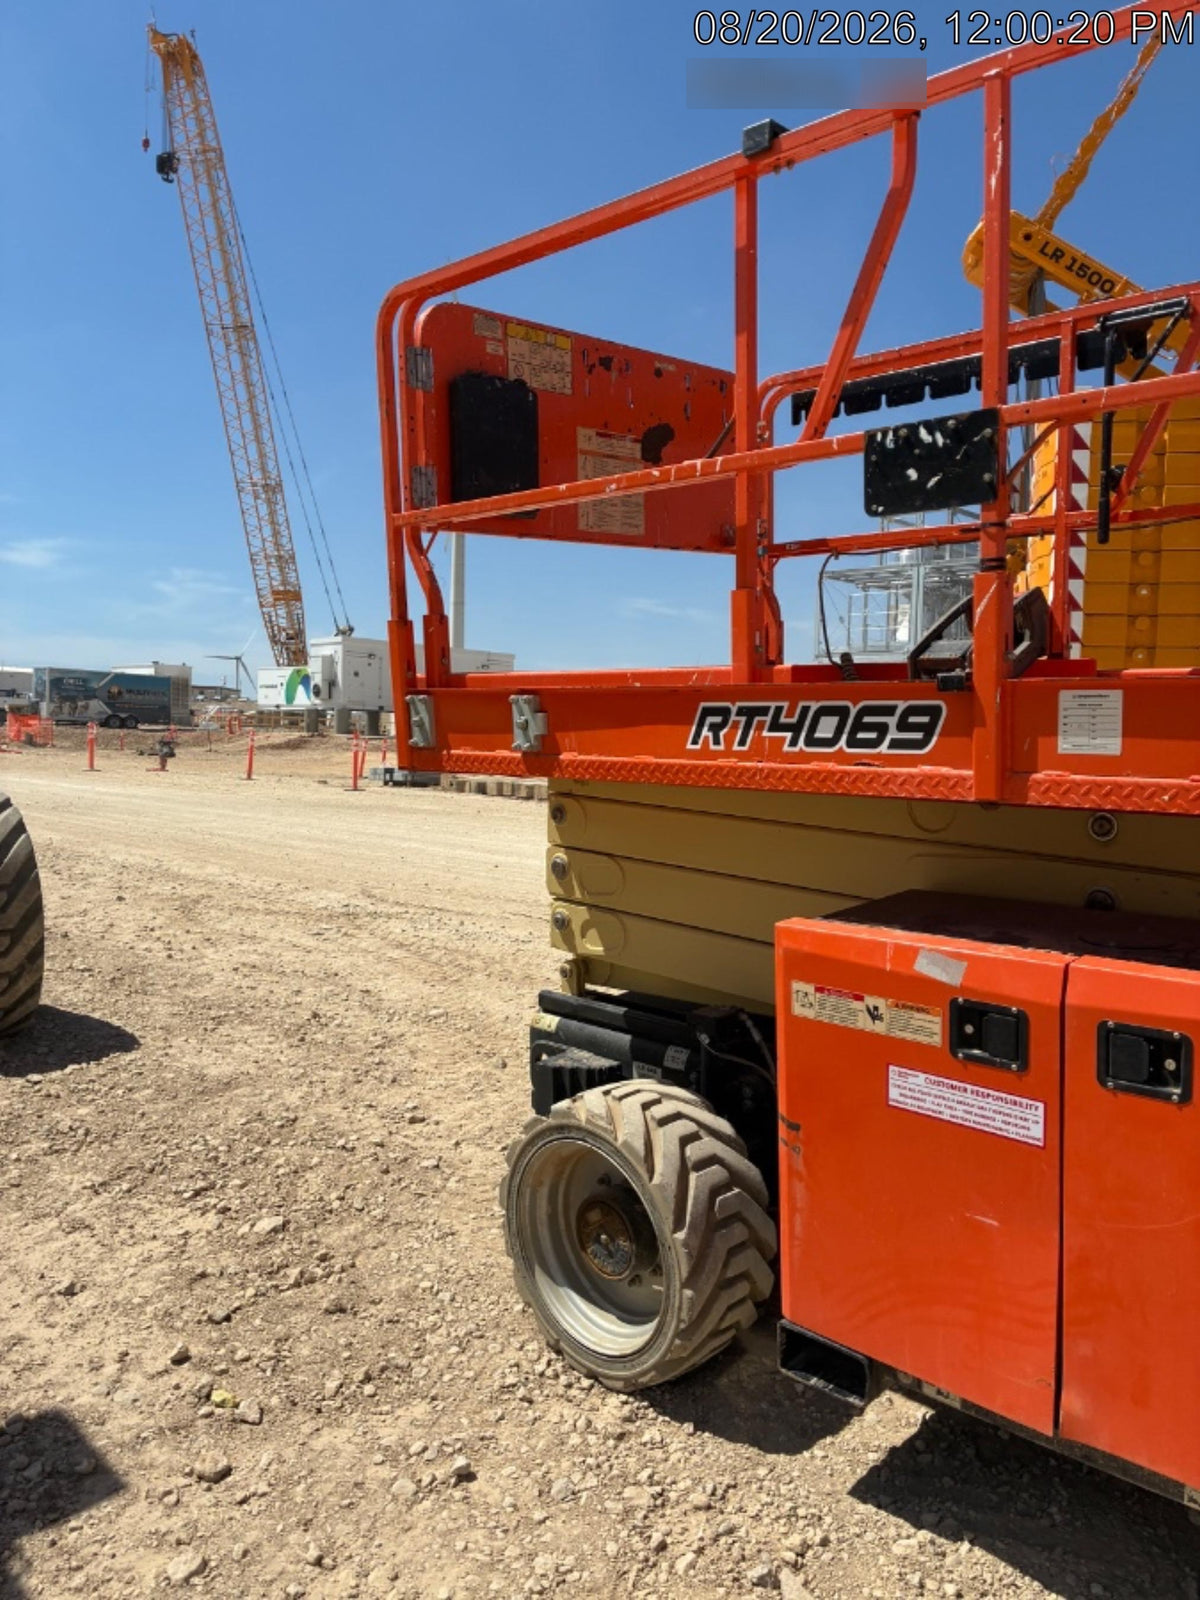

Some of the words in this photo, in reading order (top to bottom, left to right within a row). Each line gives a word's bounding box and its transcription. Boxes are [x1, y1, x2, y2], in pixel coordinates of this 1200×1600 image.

[1038, 241, 1066, 264] LR
[1065, 256, 1116, 294] 1500
[687, 701, 947, 754] RT4069
[923, 1076, 968, 1094] CUSTOMER
[970, 1087, 1040, 1112] RESPONSIBILITY
